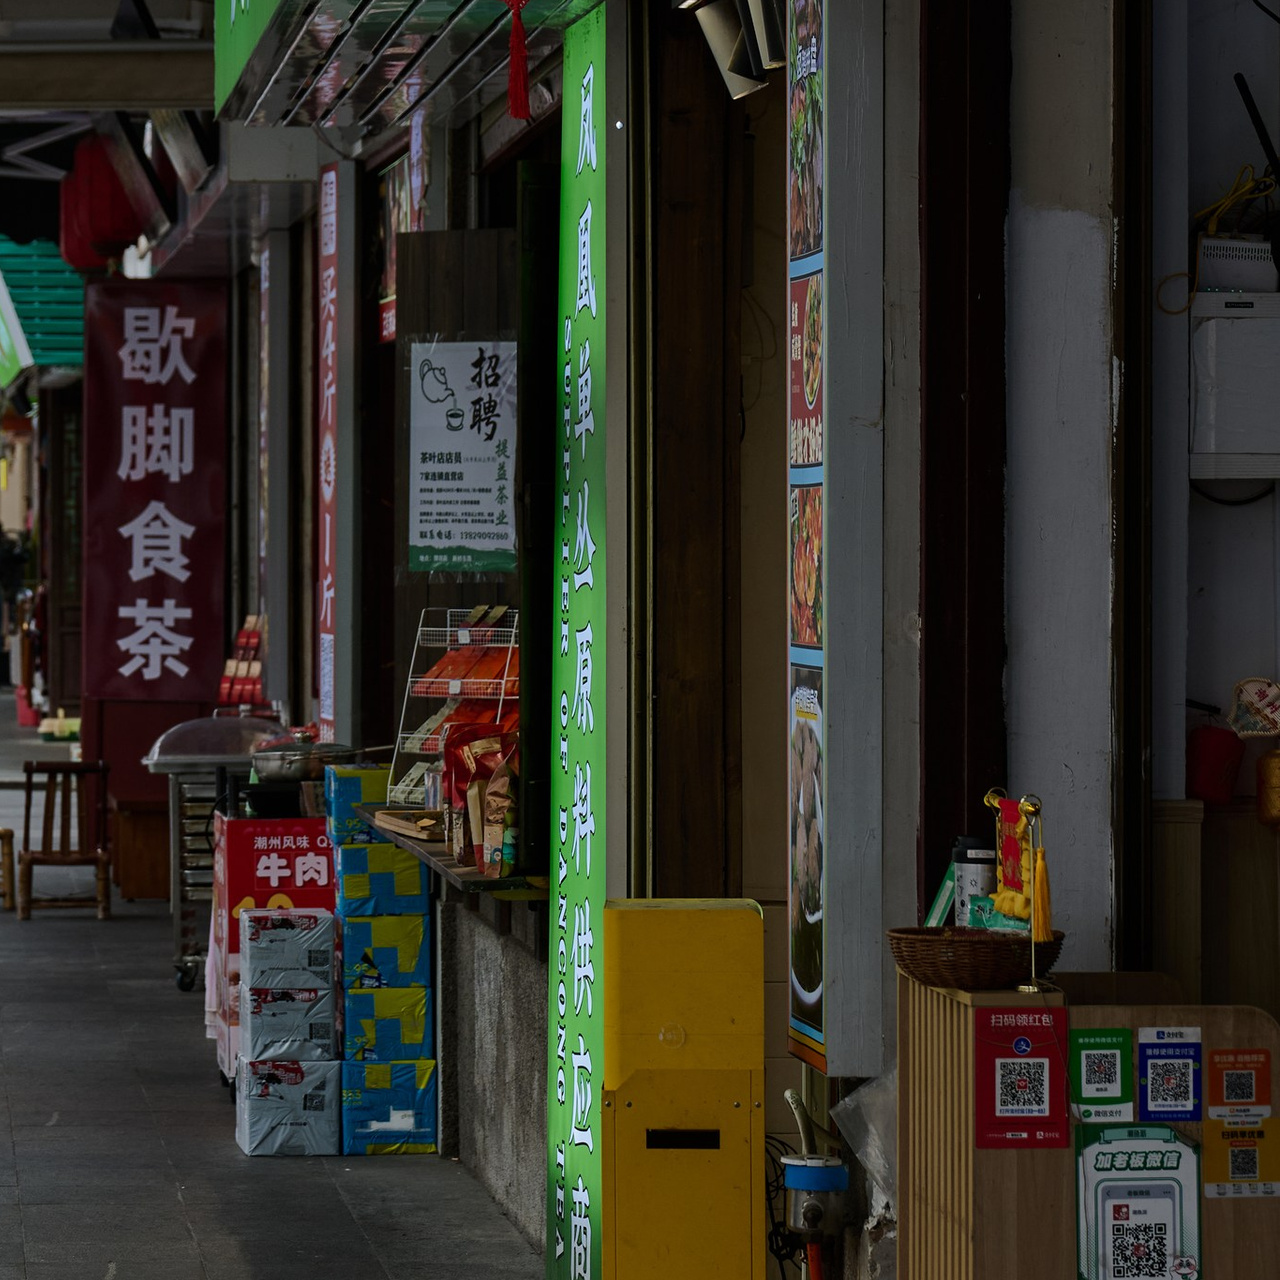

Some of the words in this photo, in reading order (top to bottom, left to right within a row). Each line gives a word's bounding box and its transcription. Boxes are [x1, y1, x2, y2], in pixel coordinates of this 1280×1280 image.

[470, 346, 501, 442] 招聘
[419, 452, 462, 464] 茶叶店店员
[117, 305, 197, 682] 歇脚食茶
[559, 316, 572, 658] SUPPLIER
[559, 689, 569, 775] OF
[253, 835, 310, 850] 潮州风味
[256, 851, 329, 888] 牛肉
[556, 804, 567, 1107] DANCONG
[990, 1013, 1054, 1028] 扫码领红包
[1077, 1036, 1123, 1044] 推荐使用微信支付
[1166, 1030, 1185, 1039] 支付宝
[1145, 1047, 1195, 1056] 推荐使用支付宝
[1093, 1109, 1122, 1118] 微信支付
[1221, 1130, 1265, 1139] 扫码享优惠
[1094, 1151, 1182, 1171] 加老板微信
[555, 1140, 565, 1262] TEA
